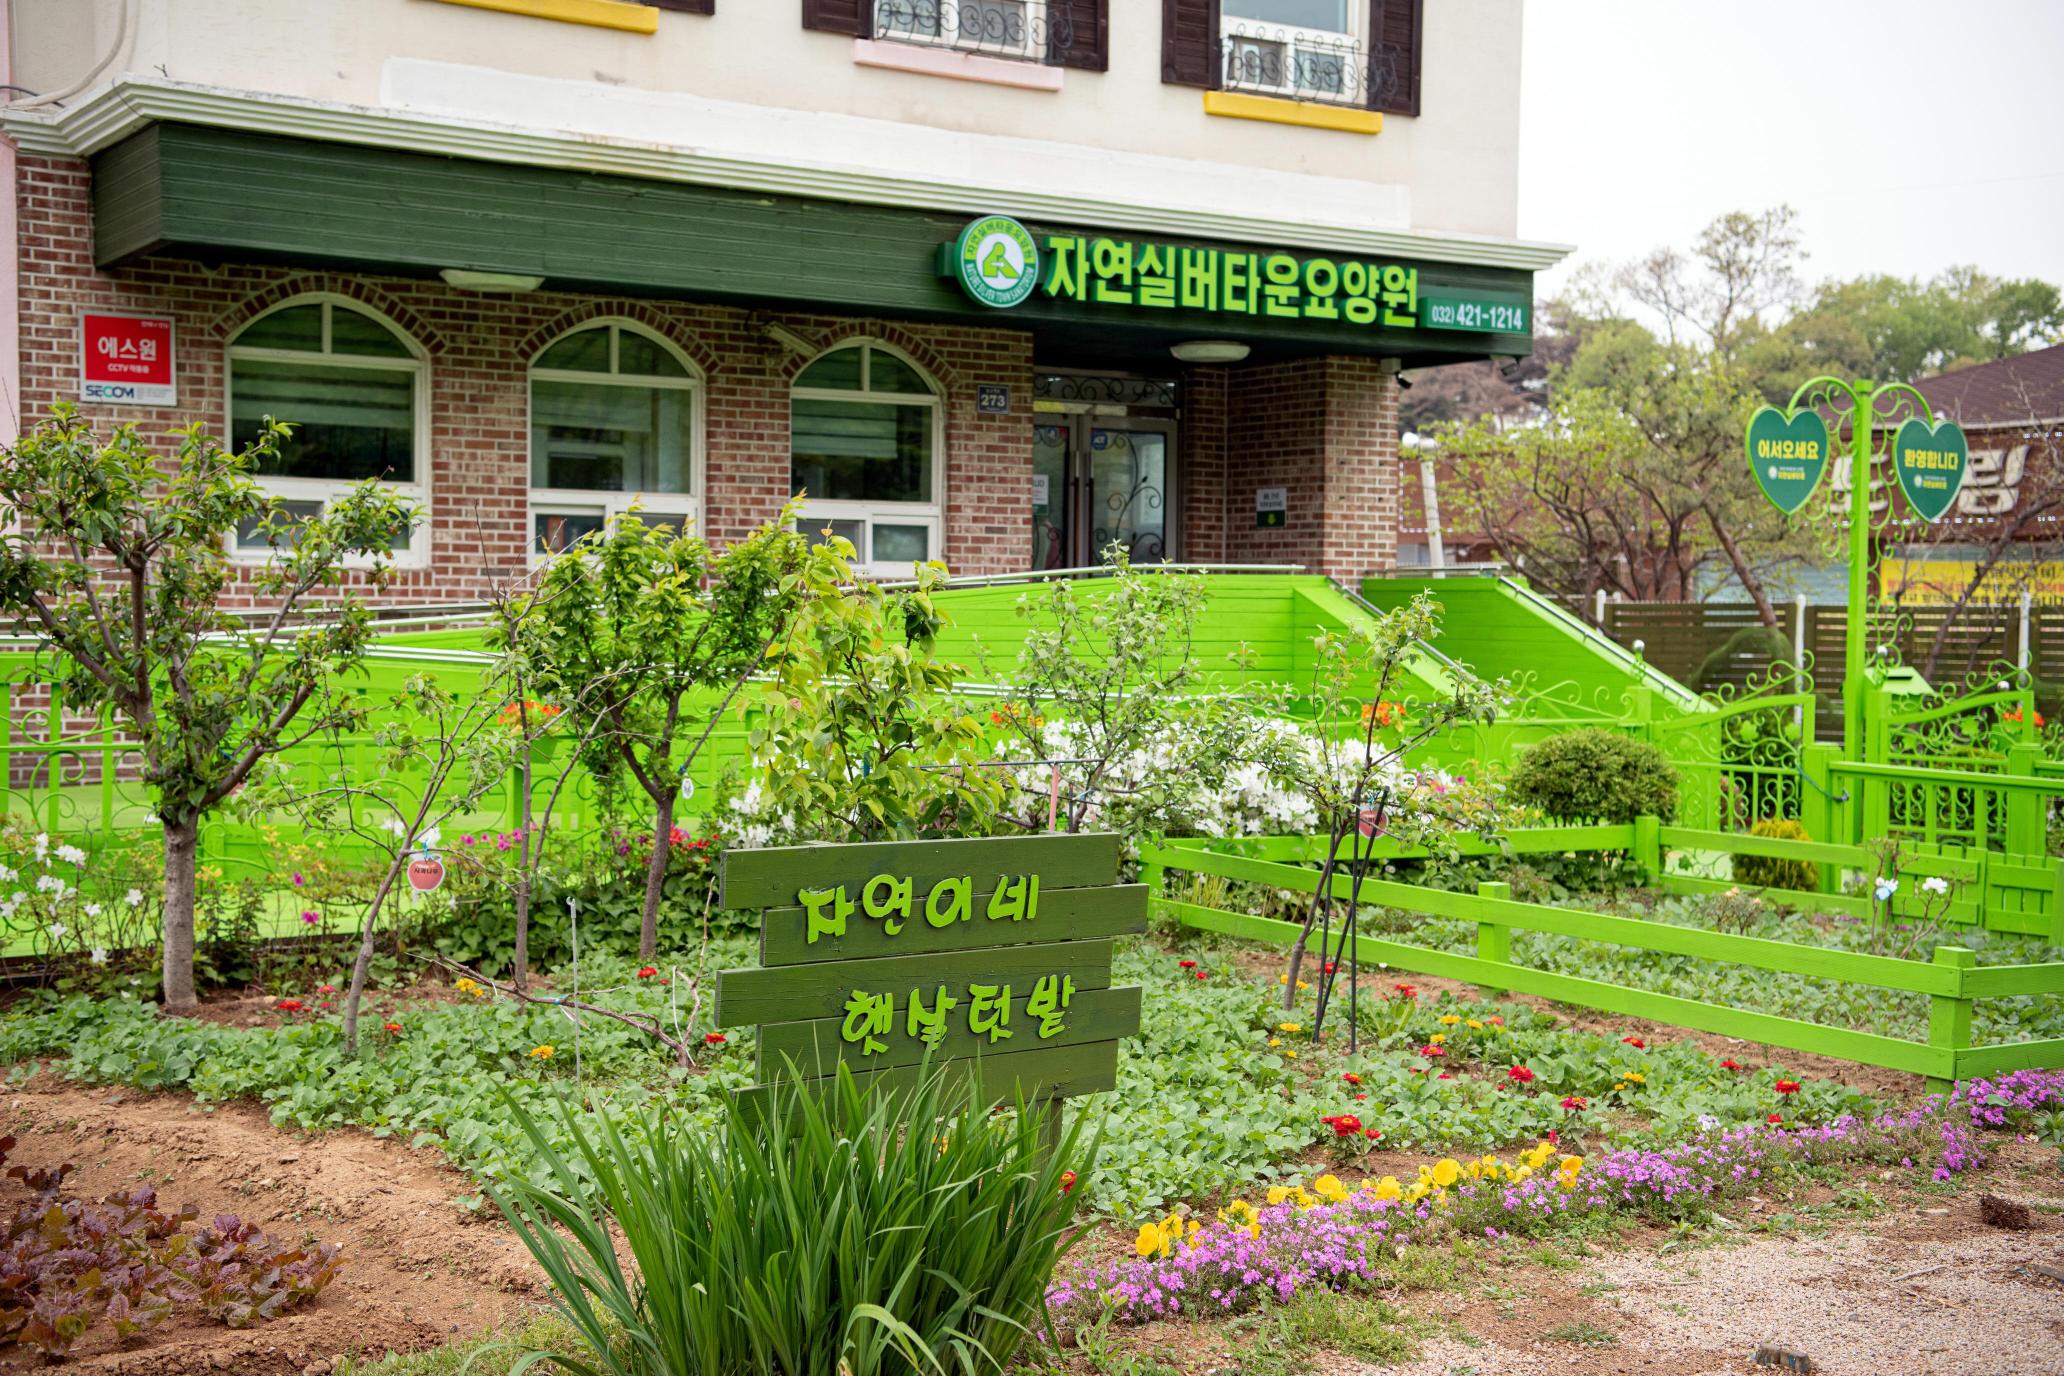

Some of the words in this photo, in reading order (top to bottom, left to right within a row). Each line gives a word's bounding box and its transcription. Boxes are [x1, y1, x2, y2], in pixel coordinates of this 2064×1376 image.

[1047, 235, 1419, 329] 자연실버타운요양원
[1431, 305, 1455, 324] 032)
[1456, 303, 1523, 330] 421-1214
[97, 335, 157, 362] 에스원
[107, 363, 129, 373] CCTV
[86, 385, 135, 399] SECOM
[980, 393, 1006, 407] 273
[1757, 439, 1819, 460] 어서오세요
[1904, 448, 1959, 471] 환영합니다
[797, 873, 1040, 945] 자연이네
